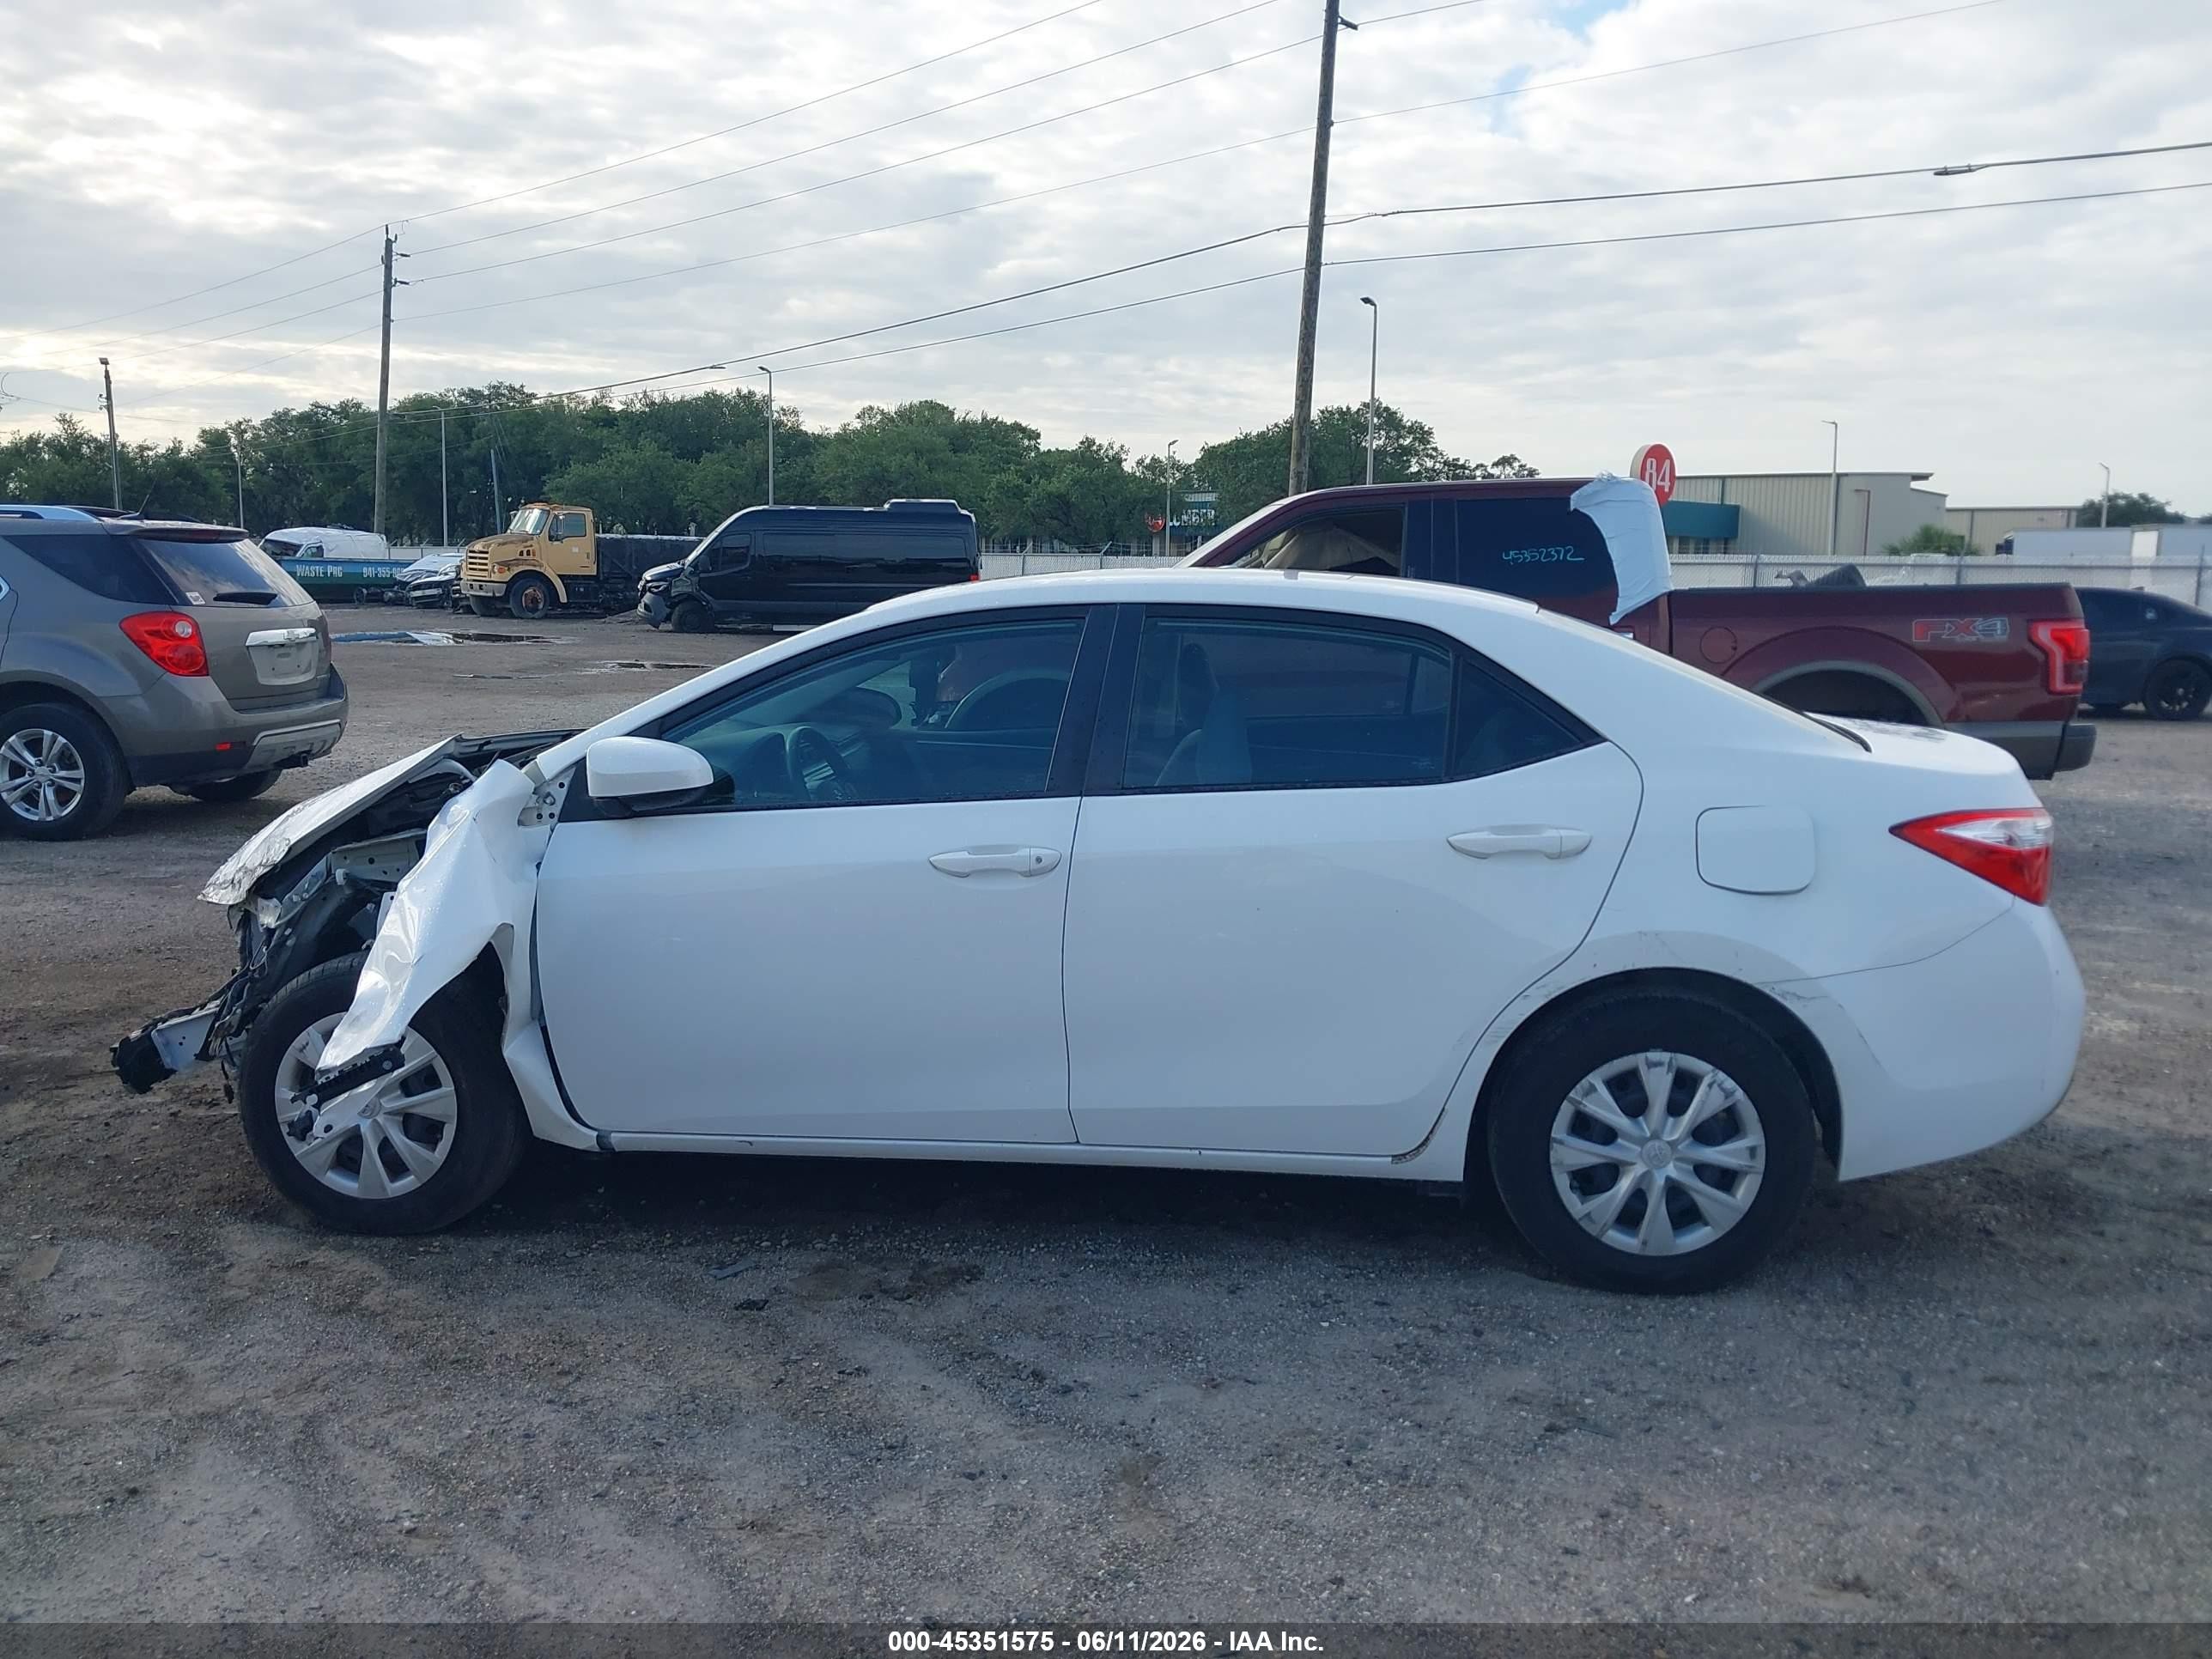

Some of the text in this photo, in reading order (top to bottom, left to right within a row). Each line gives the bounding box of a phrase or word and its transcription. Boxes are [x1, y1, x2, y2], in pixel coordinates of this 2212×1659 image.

[1645, 458, 1671, 492] 84
[1503, 545, 1584, 566] 45352372
[295, 564, 325, 577] WASTE
[1912, 617, 2009, 642] FX4
